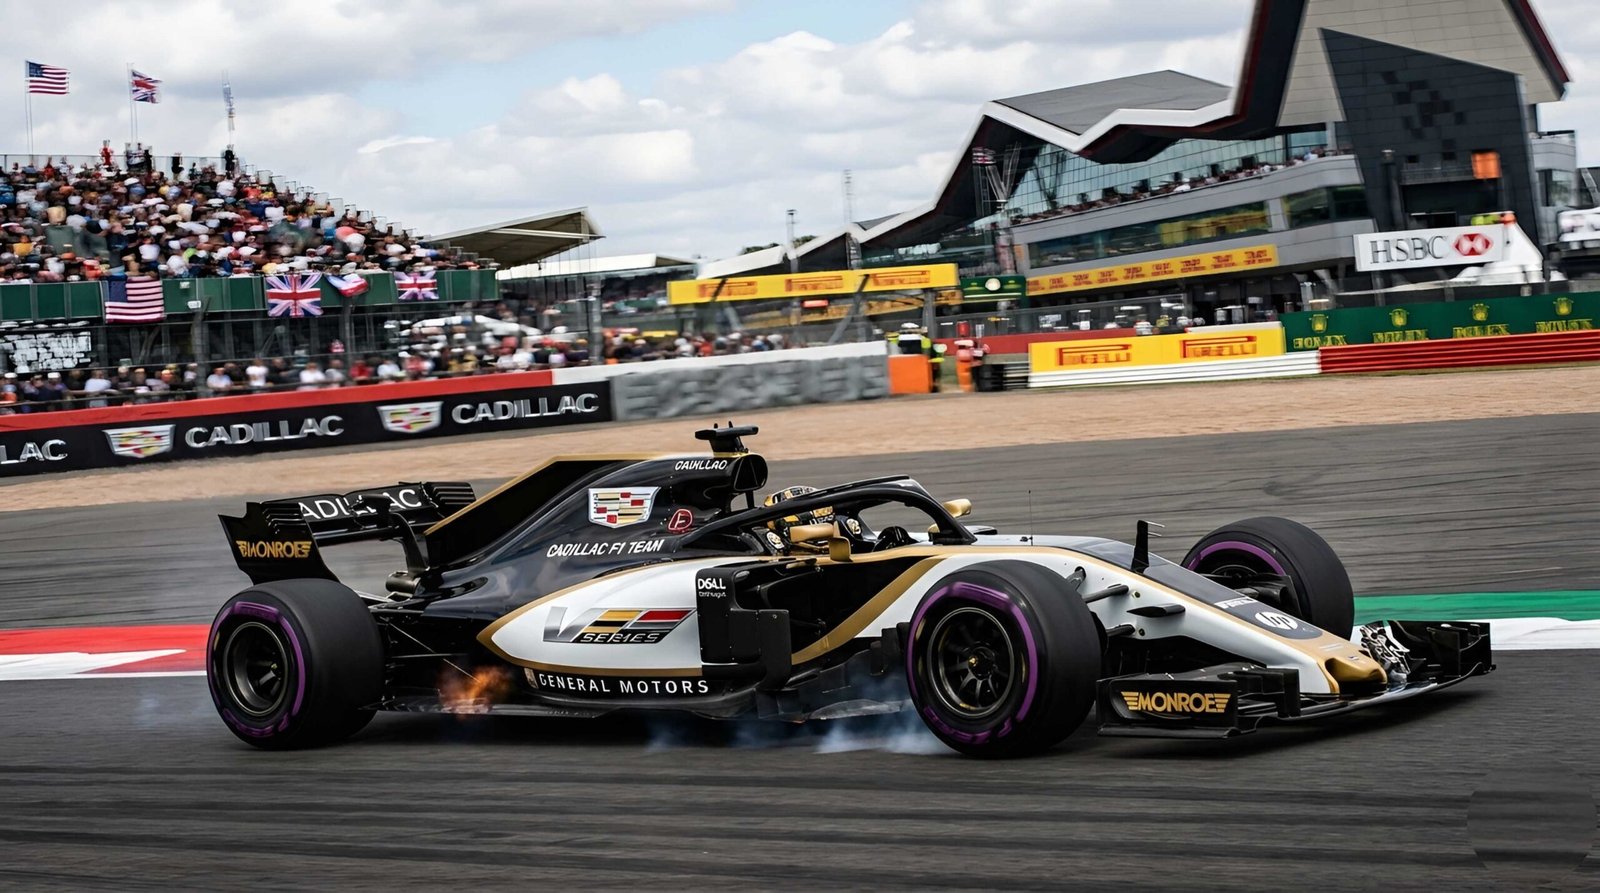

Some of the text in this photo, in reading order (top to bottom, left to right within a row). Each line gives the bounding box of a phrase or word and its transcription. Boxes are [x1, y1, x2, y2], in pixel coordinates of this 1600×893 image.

[1370, 235, 1447, 264] HSBC
[451, 393, 599, 424] CADILLAC
[185, 415, 344, 448] CADILLAC
[246, 541, 310, 558] MONROE
[608, 542, 627, 555] F1
[628, 539, 665, 554] TEAM
[539, 673, 709, 694] GENERAL MOTORS
[1137, 691, 1219, 713] MONROE
